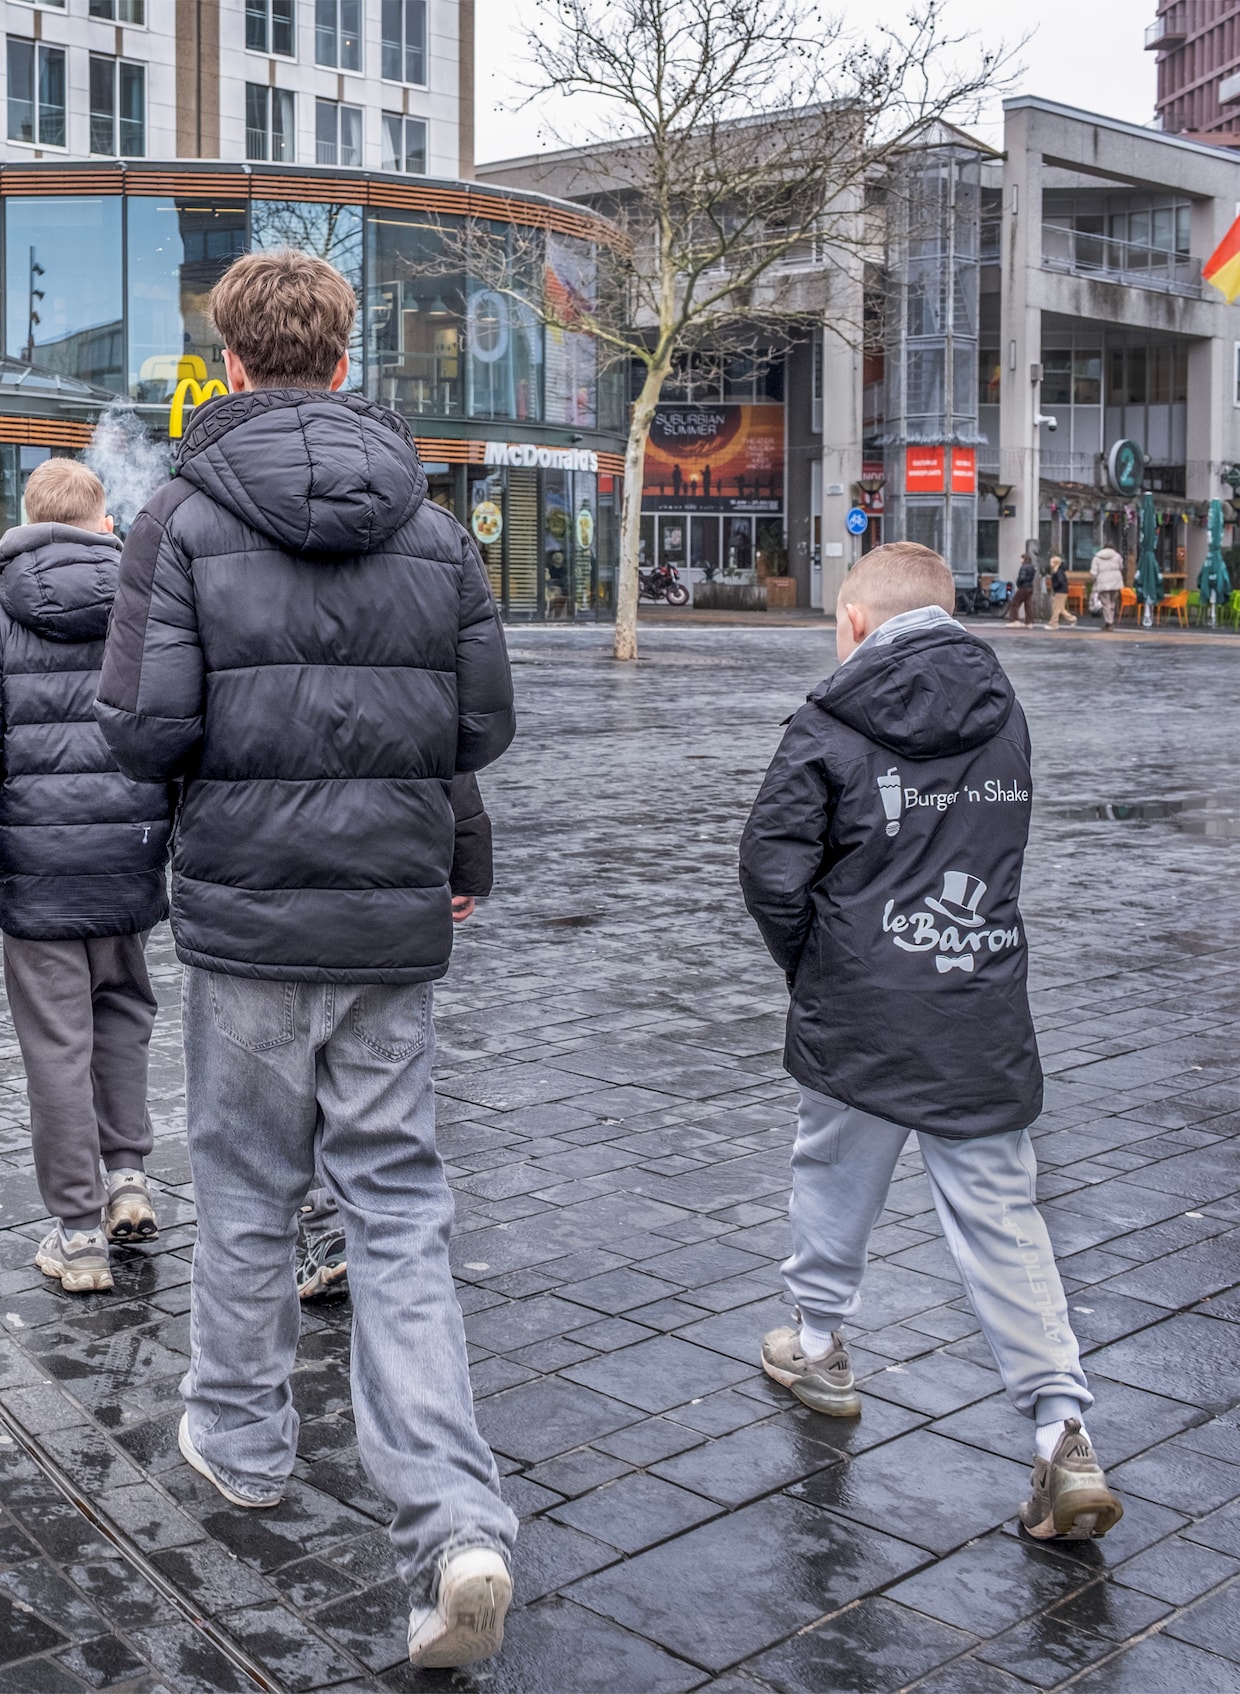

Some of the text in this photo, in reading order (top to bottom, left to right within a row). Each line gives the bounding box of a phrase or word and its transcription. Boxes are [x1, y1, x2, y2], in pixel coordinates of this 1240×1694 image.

[663, 424, 717, 436] SUMMER
[1120, 447, 1135, 487] 2
[904, 787, 960, 812] Burger
[984, 779, 1029, 802] Shake
[882, 899, 1019, 952] le Baron
